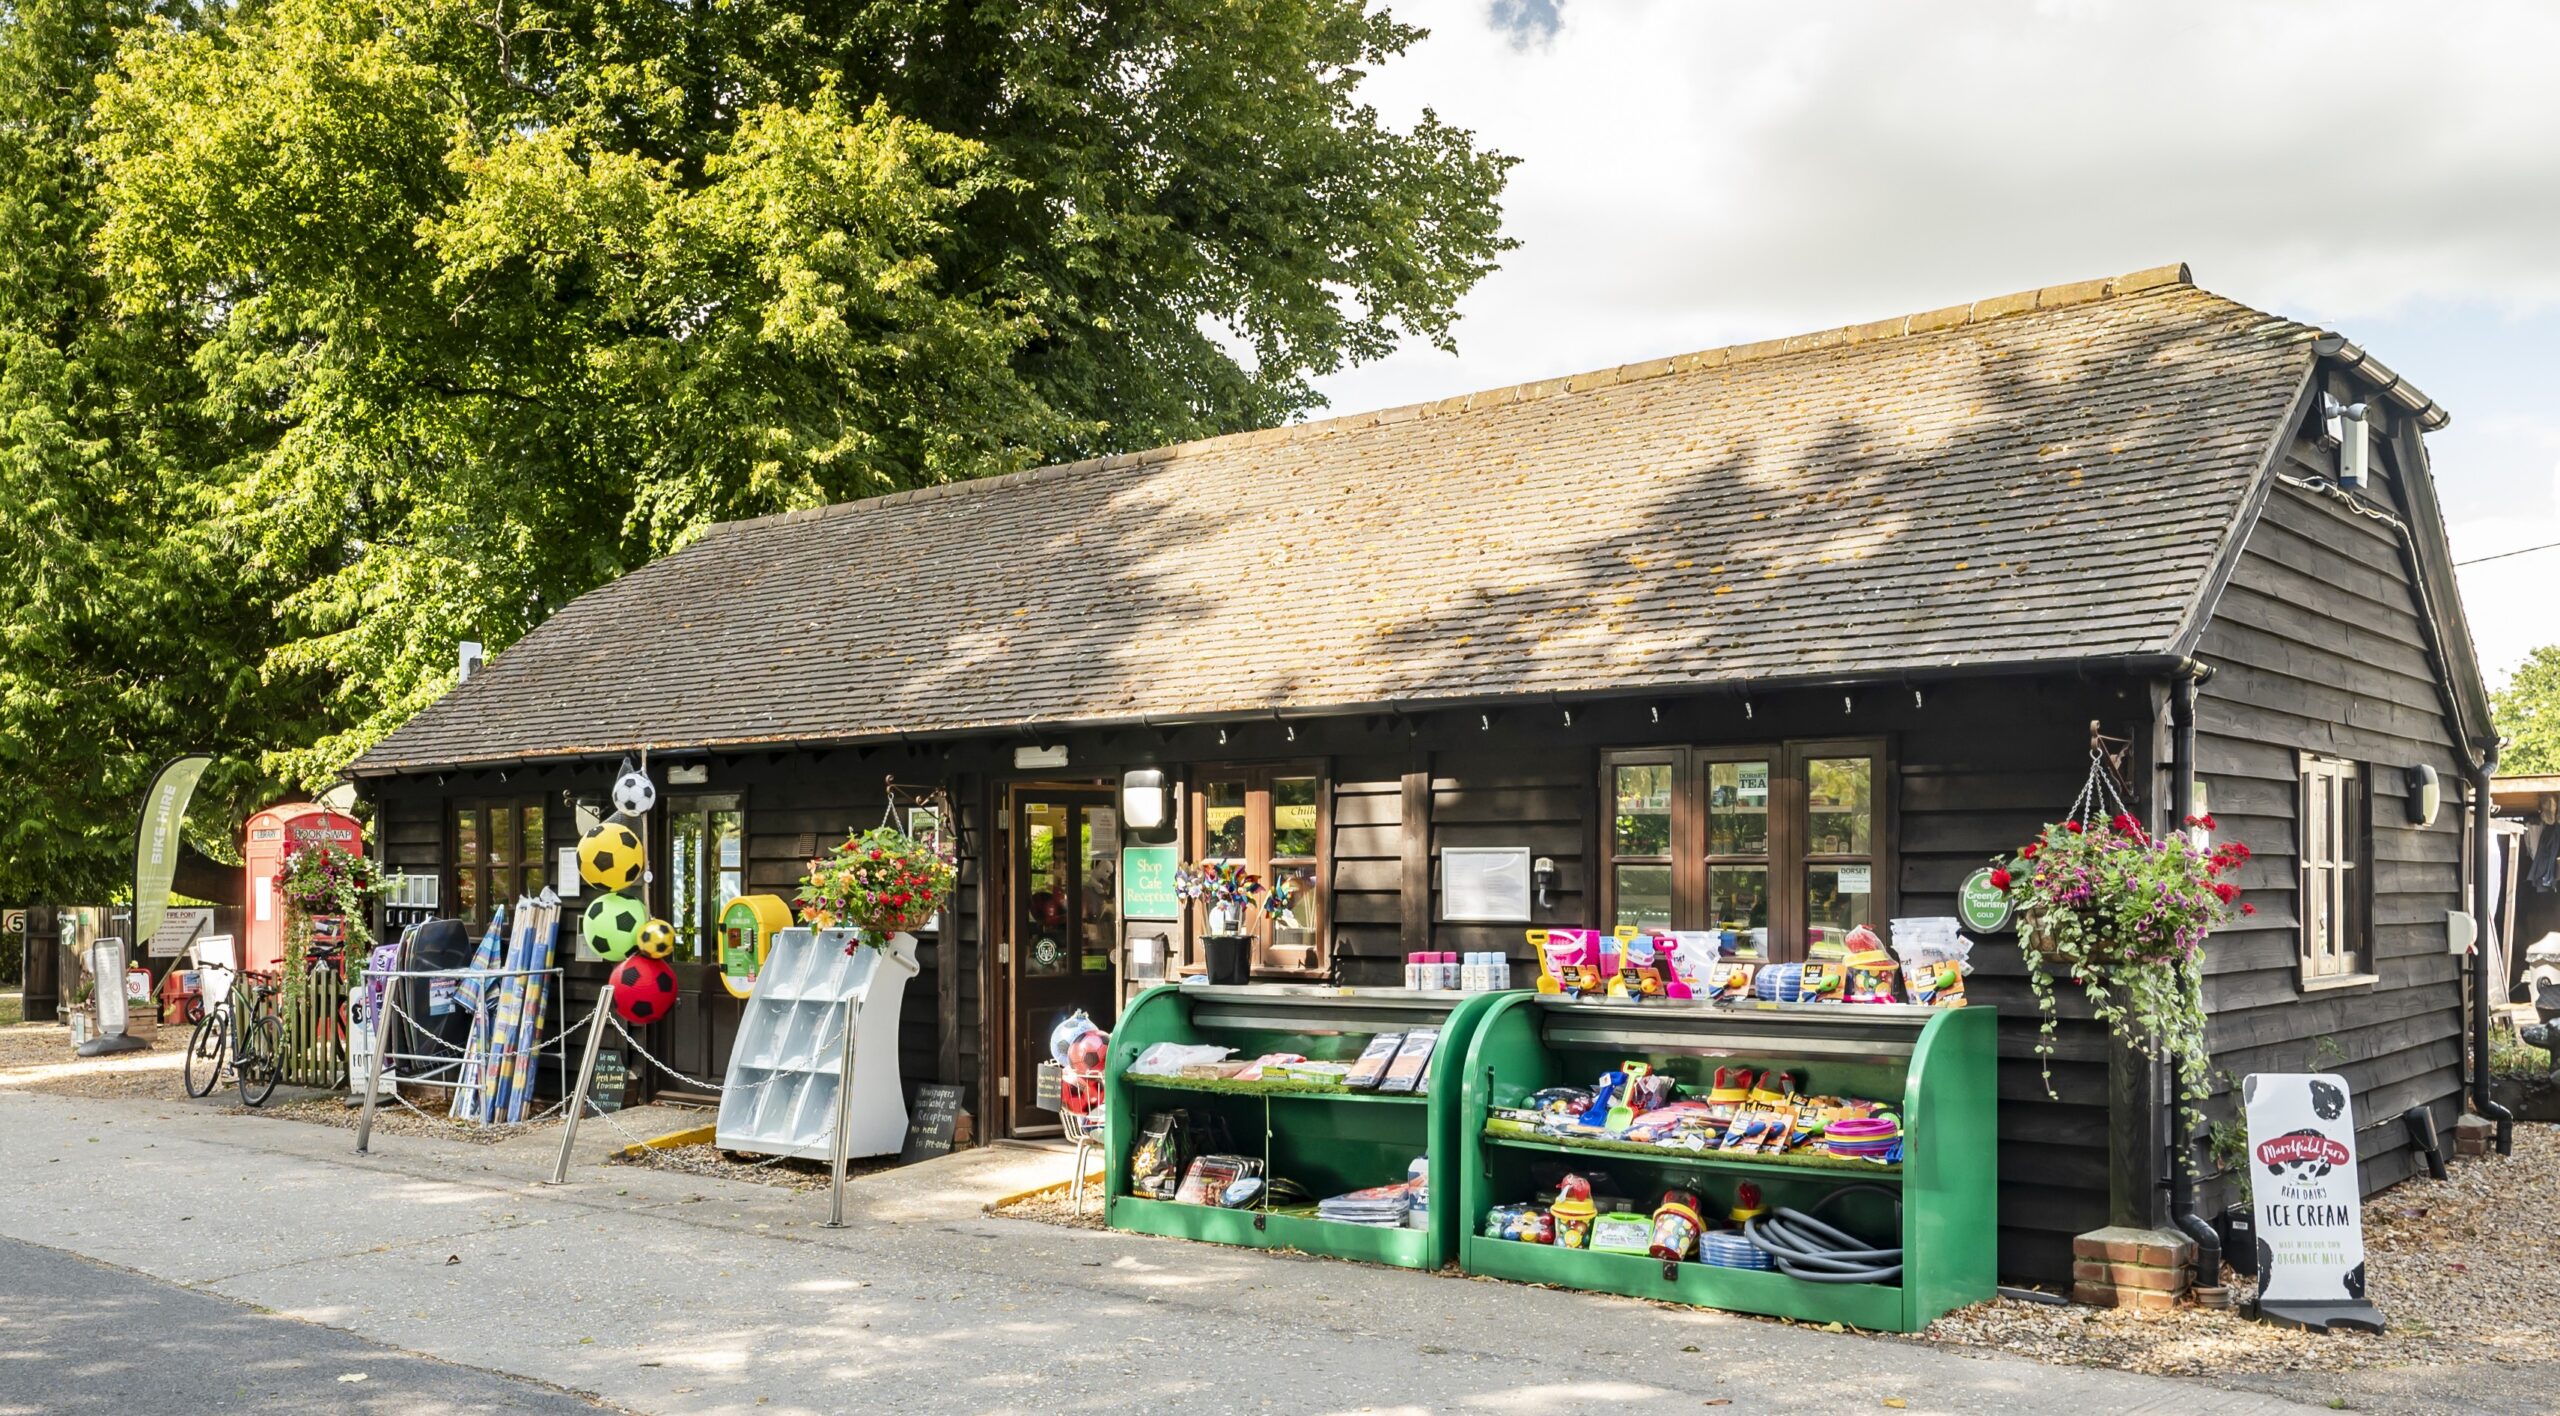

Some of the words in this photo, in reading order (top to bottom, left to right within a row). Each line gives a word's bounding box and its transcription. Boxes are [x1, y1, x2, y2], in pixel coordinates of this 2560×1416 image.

[1739, 779, 1766, 788] TEA
[156, 784, 177, 823] HIRE
[295, 830, 321, 840] BOOK
[325, 830, 352, 839] SWAP
[151, 827, 167, 865] BIKE
[1137, 858, 1162, 877] Shop
[1127, 888, 1175, 905] Reception
[1966, 891, 1992, 900] Green
[1972, 899, 2006, 909] Tourism
[166, 911, 178, 919] FIRE
[179, 911, 197, 919] POINT
[1976, 911, 1995, 919] GOLD
[13, 916, 24, 931] 5
[921, 1088, 955, 1100] Newspapers
[916, 1098, 946, 1110] available
[948, 1099, 957, 1110] at
[918, 1109, 953, 1125] Reception
[911, 1125, 920, 1134] No
[922, 1123, 939, 1135] need
[924, 1139, 951, 1150] pre-order
[2263, 1137, 2321, 1163] Marshfield
[2321, 1140, 2346, 1161] Farm
[2281, 1185, 2300, 1199] REAL
[2302, 1187, 2327, 1201] DAIRY
[2266, 1204, 2291, 1227] ICE
[2296, 1204, 2350, 1228] CREAM
[2278, 1240, 2294, 1249] MADE
[2296, 1240, 2312, 1249] WITH
[2313, 1241, 2326, 1249] OUR
[2327, 1241, 2341, 1249] OWN
[2277, 1252, 2318, 1265] ORGANIC
[2321, 1252, 2346, 1265] MILK
